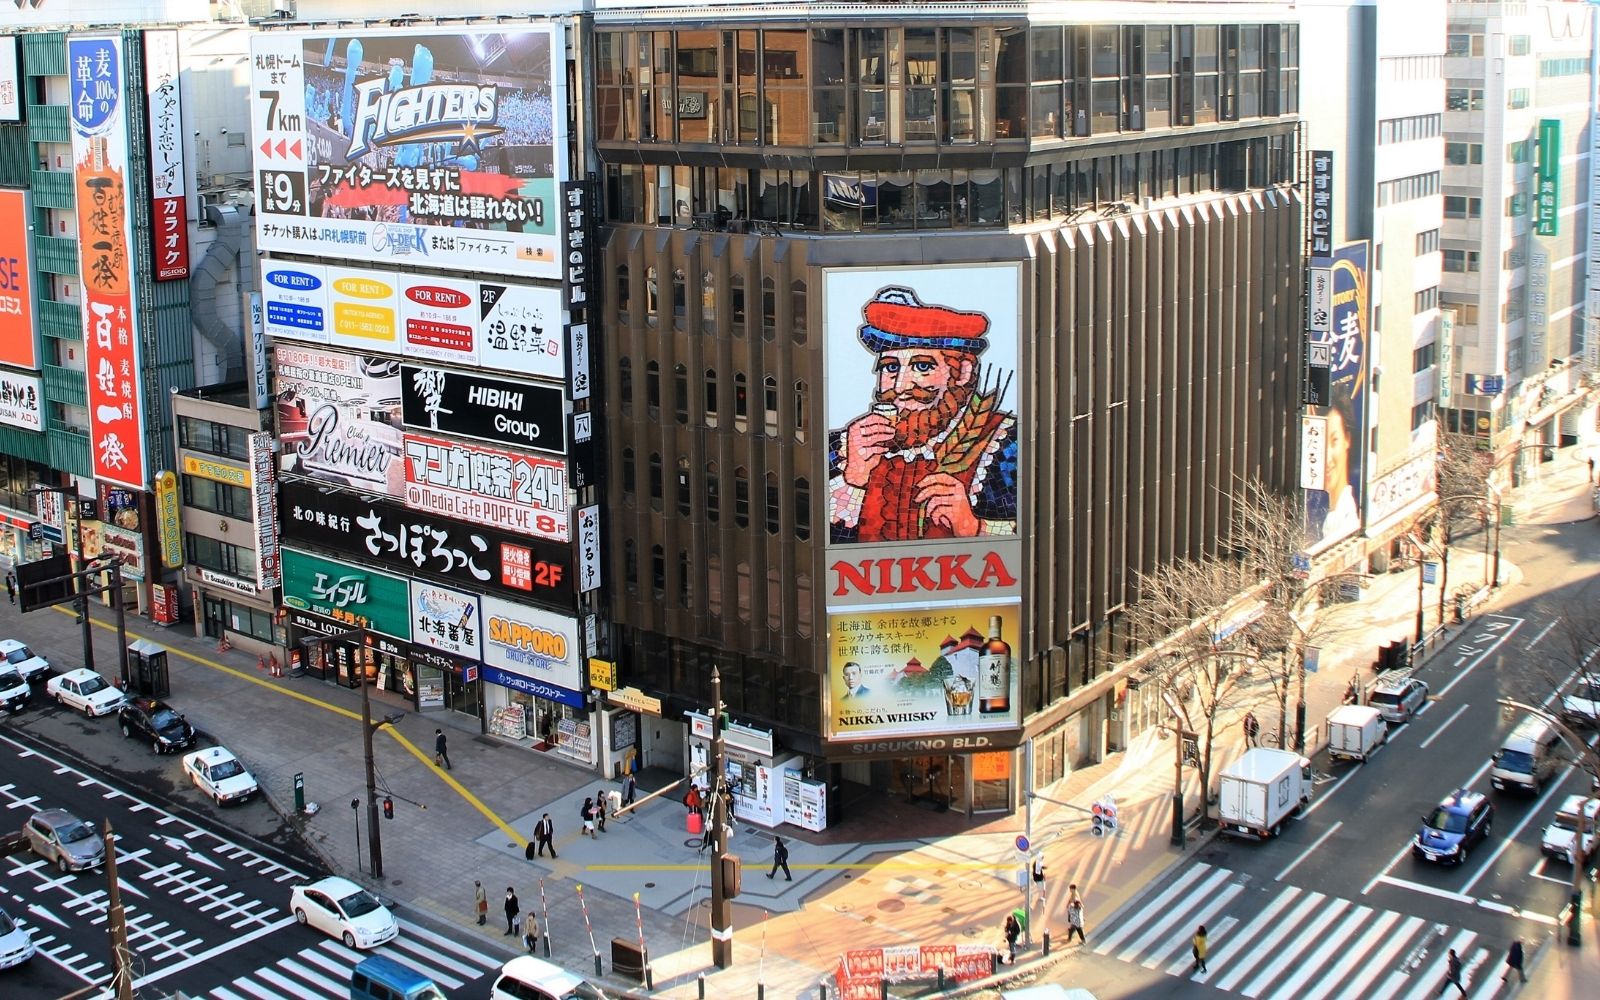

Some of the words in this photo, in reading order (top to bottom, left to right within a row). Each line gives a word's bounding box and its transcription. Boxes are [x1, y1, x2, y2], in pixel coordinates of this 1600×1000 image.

[256, 54, 300, 70] 札幌ドーム
[271, 71, 287, 84] まで
[75, 56, 94, 122] 革命
[95, 48, 117, 113] 麦100%の
[259, 90, 301, 132] 7km
[345, 77, 497, 159] FIGHTERS
[318, 165, 460, 190] ファイターズを見ずに
[410, 194, 542, 222] 北海道は語れない!
[1313, 157, 1331, 252] すすきのビル
[163, 199, 180, 265] カラオケ
[263, 224, 317, 241] チケット購入は
[318, 228, 367, 246] JR札幌駅前
[432, 236, 454, 250] または
[460, 241, 508, 255] ファイターズ
[567, 187, 586, 304] すすきのビル
[274, 274, 288, 285] FOR
[342, 282, 357, 292] FOR
[415, 290, 432, 301] FOR
[482, 290, 496, 303] 2F
[116, 306, 128, 346] 本格
[488, 320, 545, 355] 温野菜
[254, 332, 266, 396] グリーンビル
[91, 302, 128, 470] 百姓一揆
[119, 359, 133, 420] 麦焼酎
[468, 386, 523, 412] HIBIKI
[298, 404, 391, 476] Premier
[494, 414, 540, 440] Group
[407, 442, 514, 500] マンガ喫茶
[515, 459, 565, 513] 24H
[422, 490, 454, 515] Media
[455, 494, 482, 519] Cafe
[483, 501, 531, 529] POPEYE
[293, 507, 351, 533] 北の味紀行
[356, 509, 491, 581] さっぽろっこ
[312, 572, 368, 607] エイブル
[535, 561, 562, 587] 2F
[830, 551, 1018, 597] NIKKA
[419, 616, 475, 646] 北海番屋
[489, 617, 566, 659] SAPPORO
[837, 620, 872, 632] 北海道
[878, 616, 957, 630] 余市を故郷とする
[506, 650, 525, 662] DRUG
[839, 714, 885, 727] NIKKA
[887, 711, 938, 724] WHISKY
[852, 739, 946, 754] SUSUKINO
[952, 736, 993, 748] BLD.
